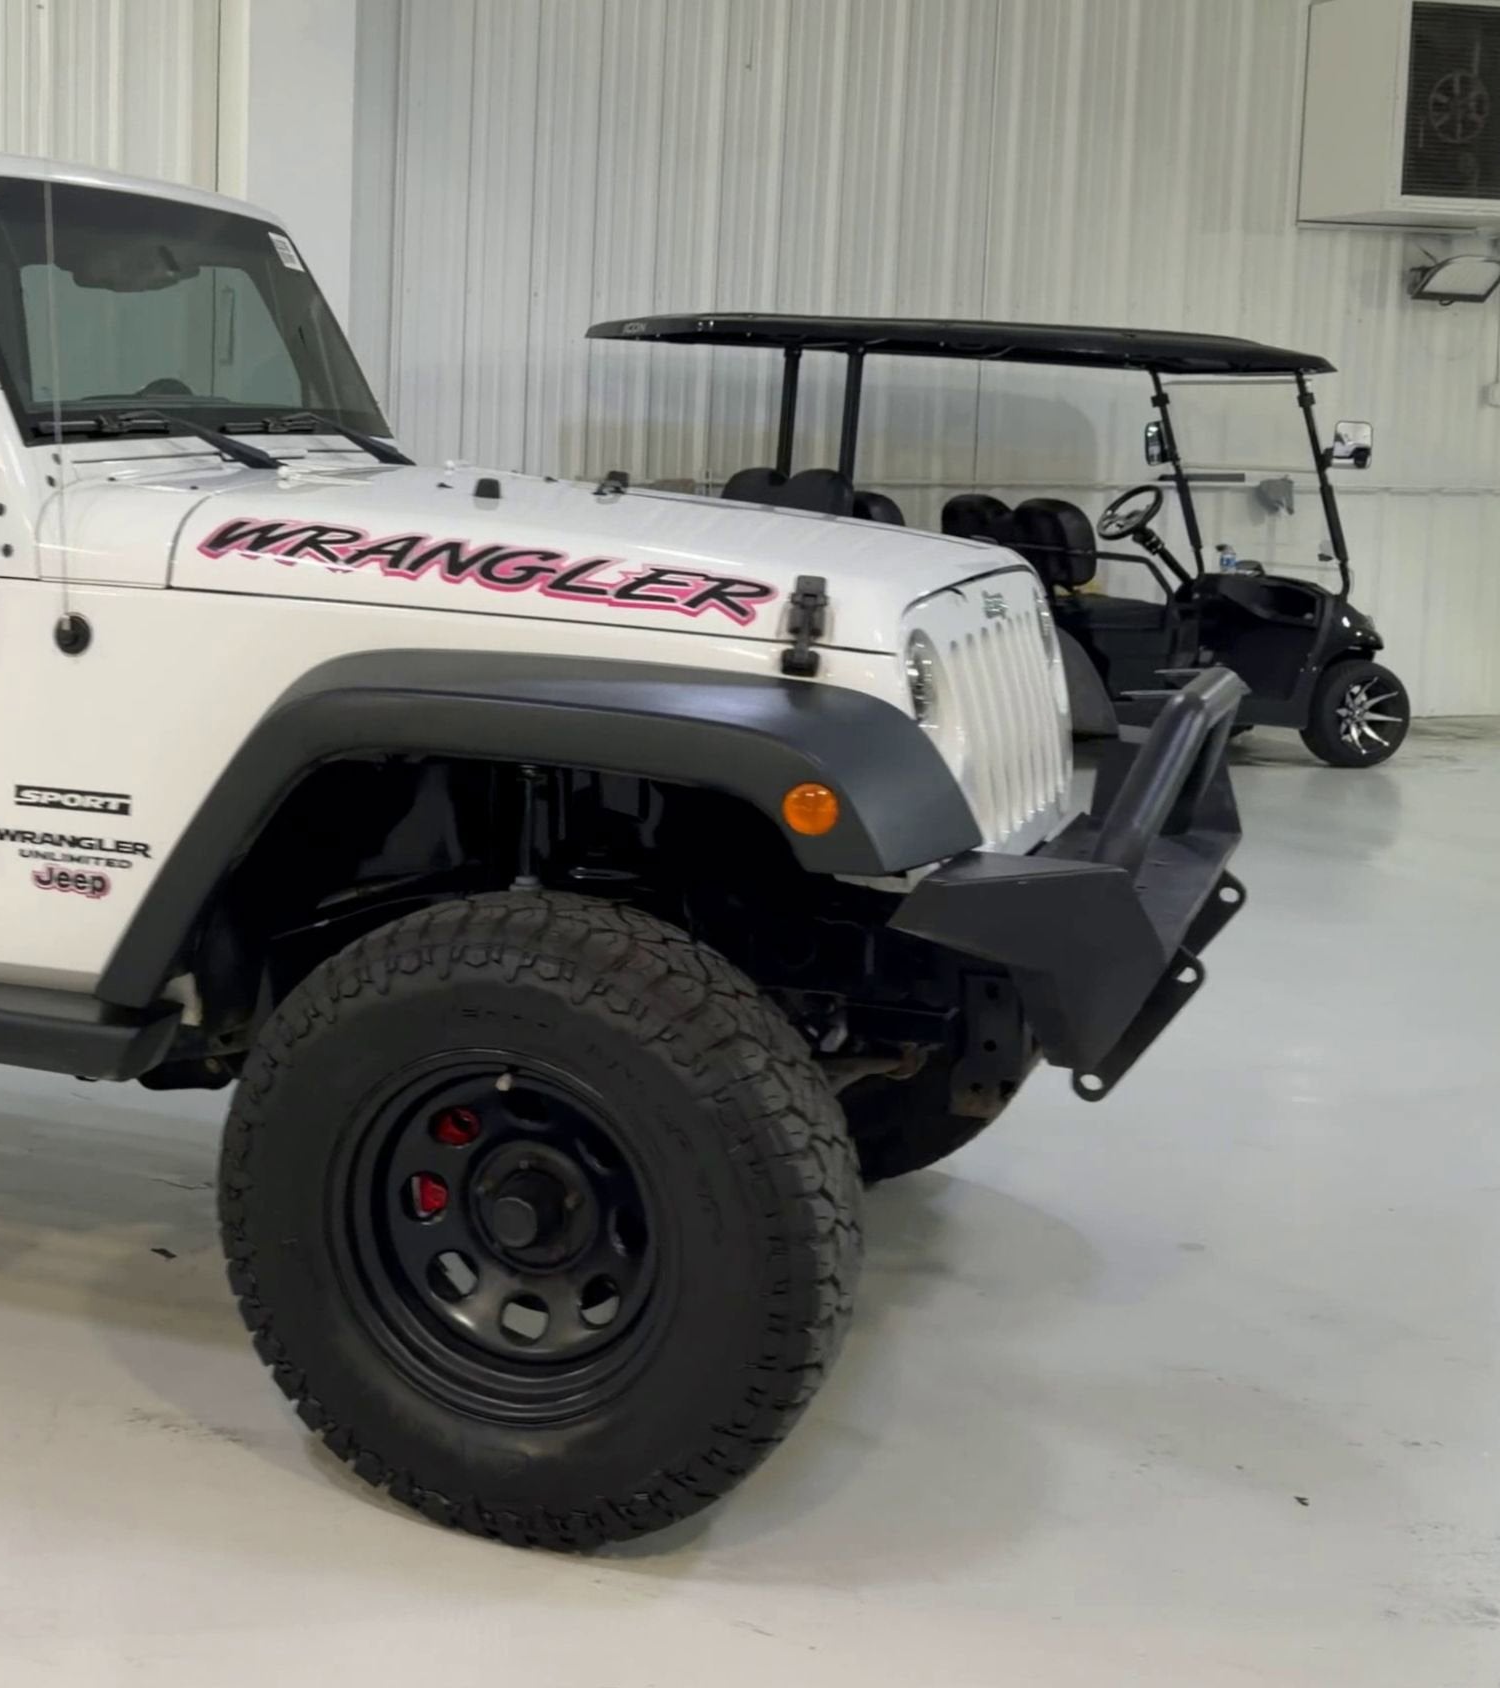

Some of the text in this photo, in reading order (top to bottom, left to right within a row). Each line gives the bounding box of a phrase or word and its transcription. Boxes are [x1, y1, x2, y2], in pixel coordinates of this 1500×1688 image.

[199, 518, 776, 625] WRANGLER
[15, 786, 131, 814] SPORT
[18, 849, 133, 869] UNLIMITED
[33, 865, 110, 898] Jeep
